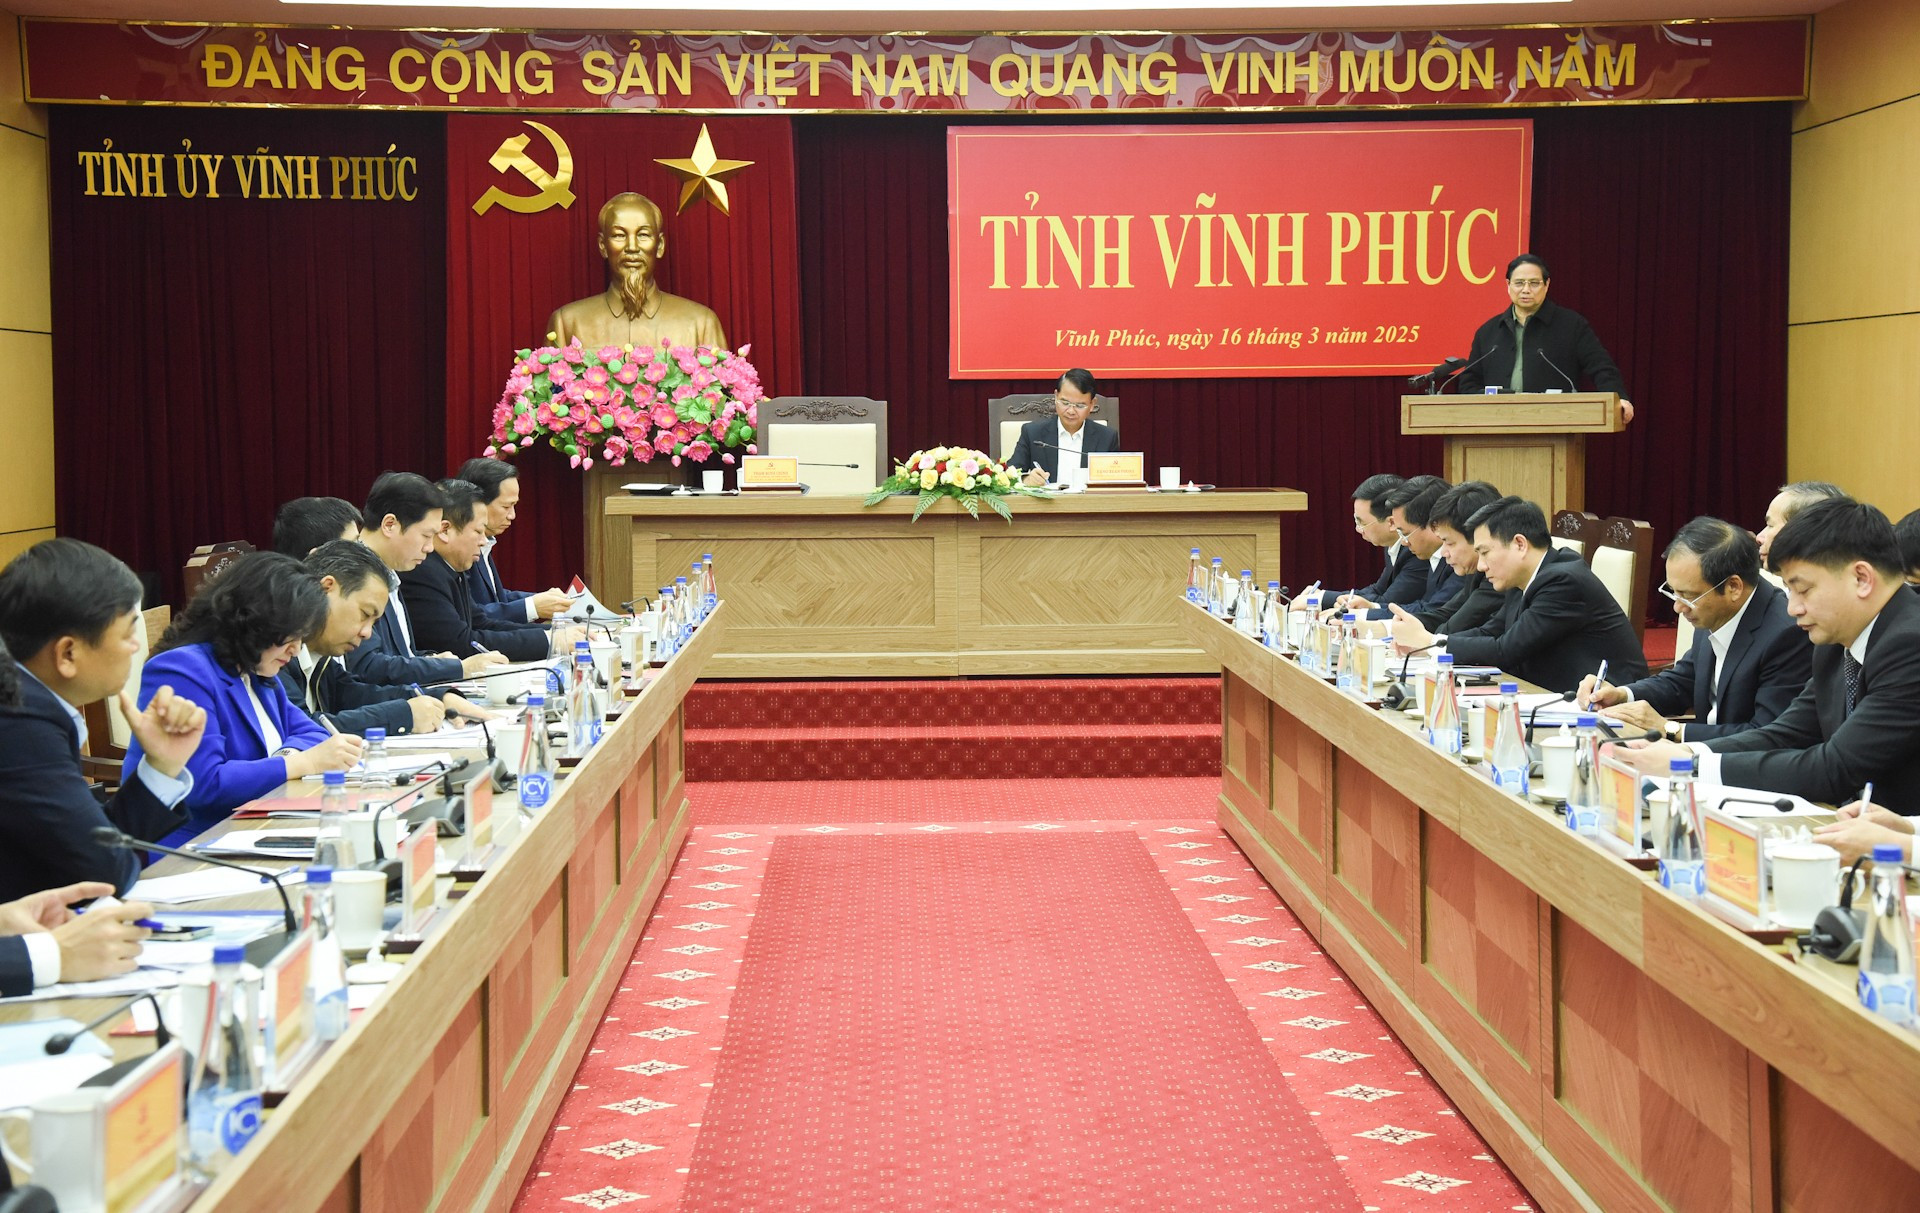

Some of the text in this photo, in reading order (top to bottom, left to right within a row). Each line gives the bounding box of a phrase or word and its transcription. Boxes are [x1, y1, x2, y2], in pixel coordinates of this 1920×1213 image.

[202, 32, 1637, 106] ĐẢNG CỘNG SẢN VIỆT NAM QUANG VINH MUÔN NĂM
[78, 138, 419, 201] TỈNH ỦY VĨNH PHÚC
[980, 185, 1499, 289] TỈNH VĨNH PHÚC
[1055, 326, 1420, 351] Vĩnh Phúc, ngày 16 tháng 3 năm 2025
[522, 780, 547, 796] ICY
